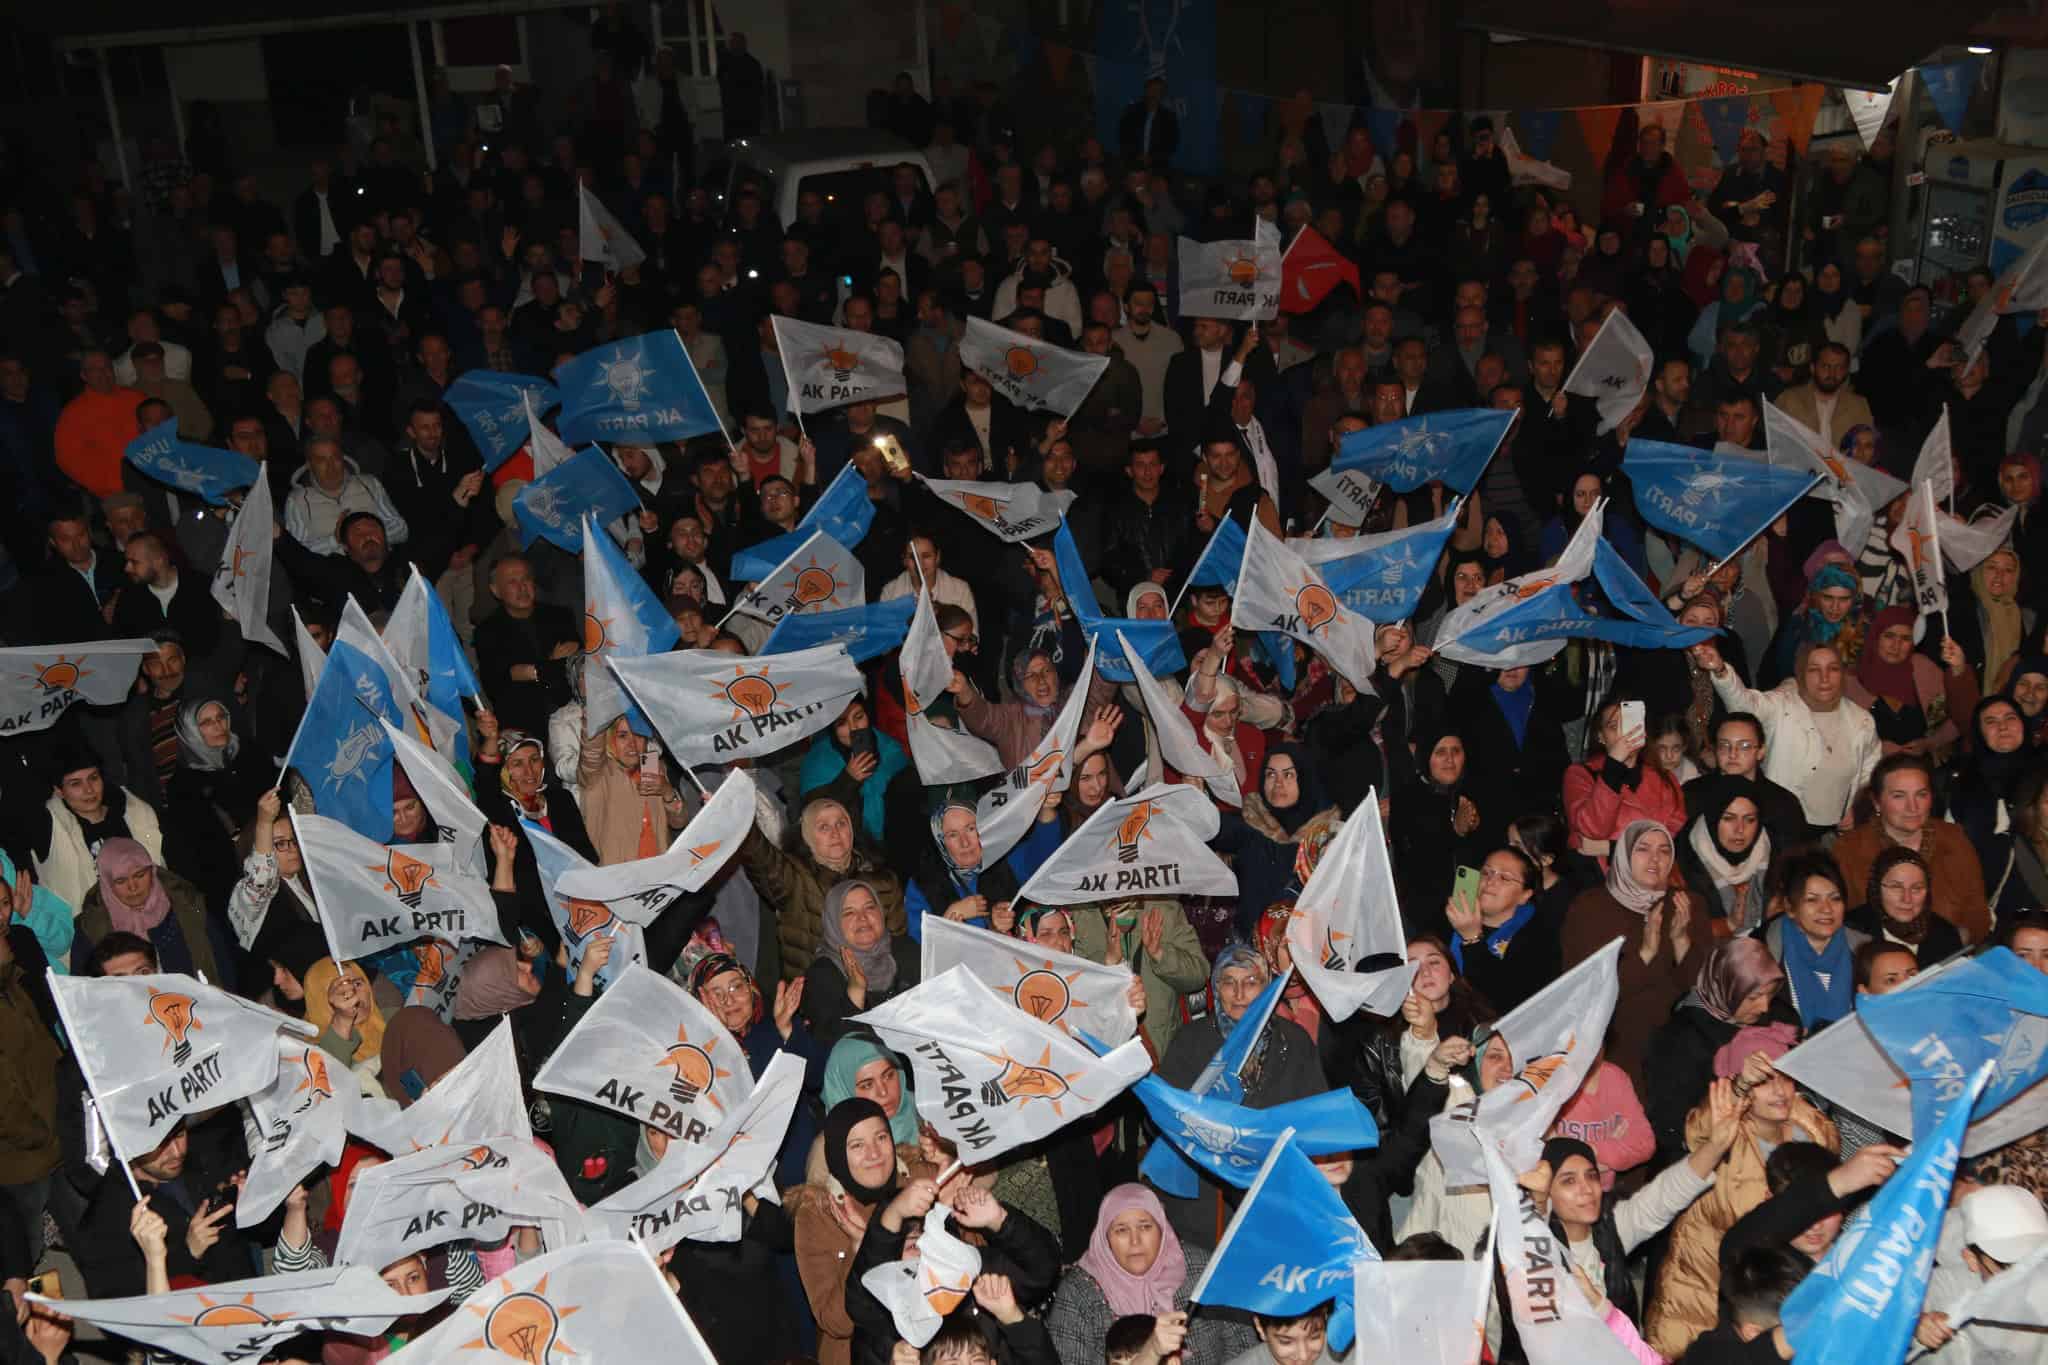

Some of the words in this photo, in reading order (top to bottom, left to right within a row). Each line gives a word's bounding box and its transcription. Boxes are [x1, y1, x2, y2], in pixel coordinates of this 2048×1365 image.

[802, 384, 825, 399] AK
[1272, 614, 1300, 633] AK
[1496, 626, 1528, 642] AK
[0, 711, 32, 731] AK
[713, 725, 748, 753] AK
[362, 916, 402, 942] AK
[147, 1086, 179, 1128] AK
[595, 1078, 645, 1113] AK
[649, 1100, 713, 1145] PAR
[1917, 1138, 1958, 1210] AK
[402, 1210, 449, 1242] AK
[1258, 1262, 1315, 1294] AK
